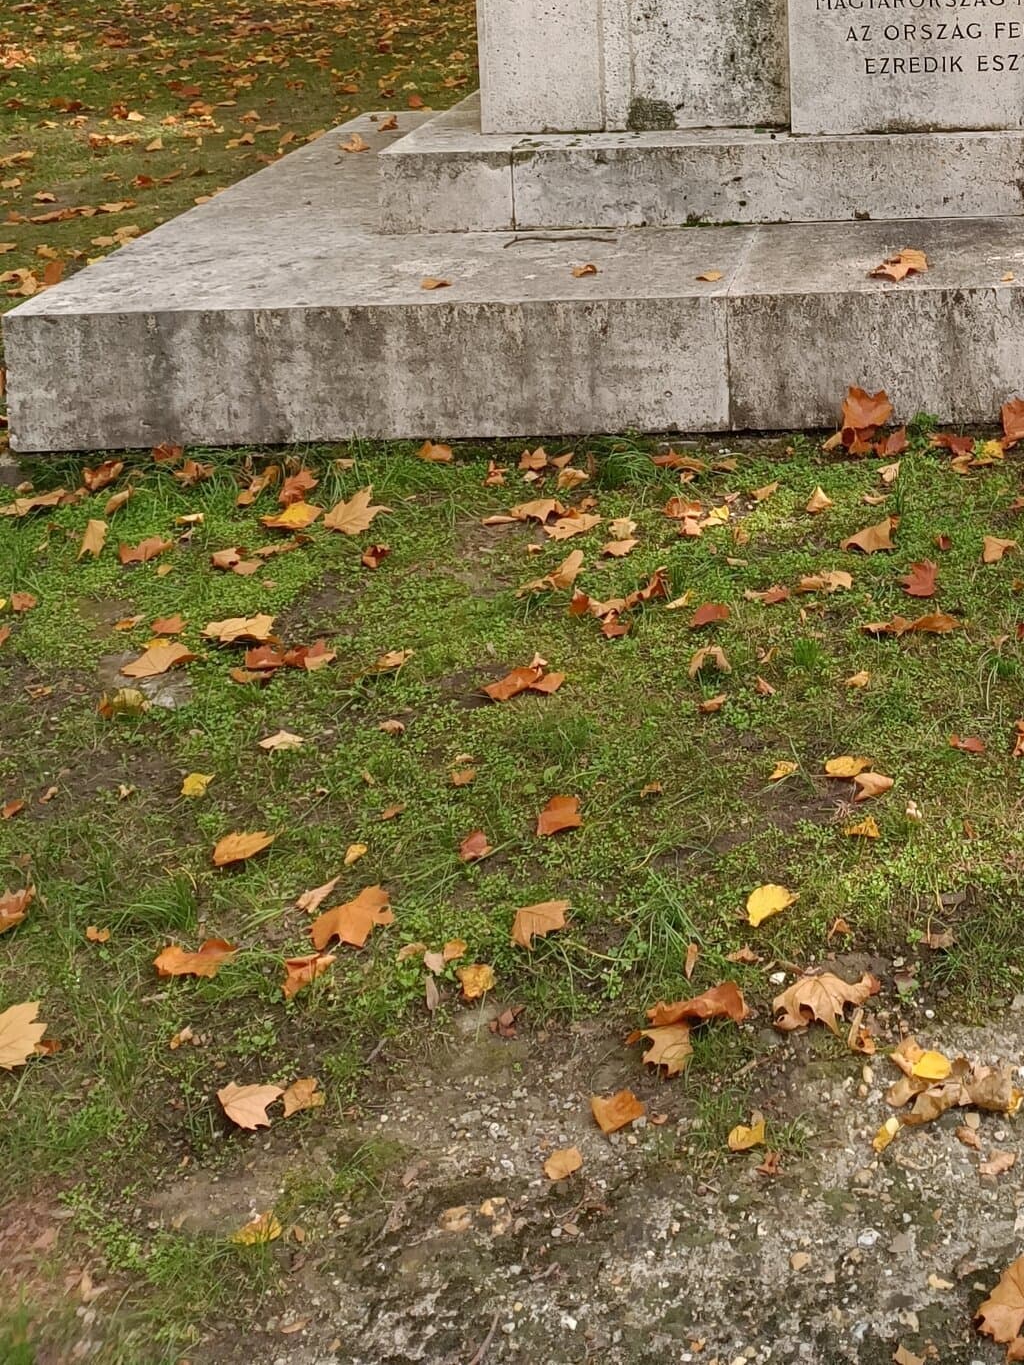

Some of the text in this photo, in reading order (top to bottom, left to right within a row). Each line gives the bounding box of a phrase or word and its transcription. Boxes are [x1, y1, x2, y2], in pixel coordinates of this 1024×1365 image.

[846, 25, 872, 42] AZ
[884, 17, 982, 41] ORSZÁG
[865, 56, 964, 74] EZREDIK
